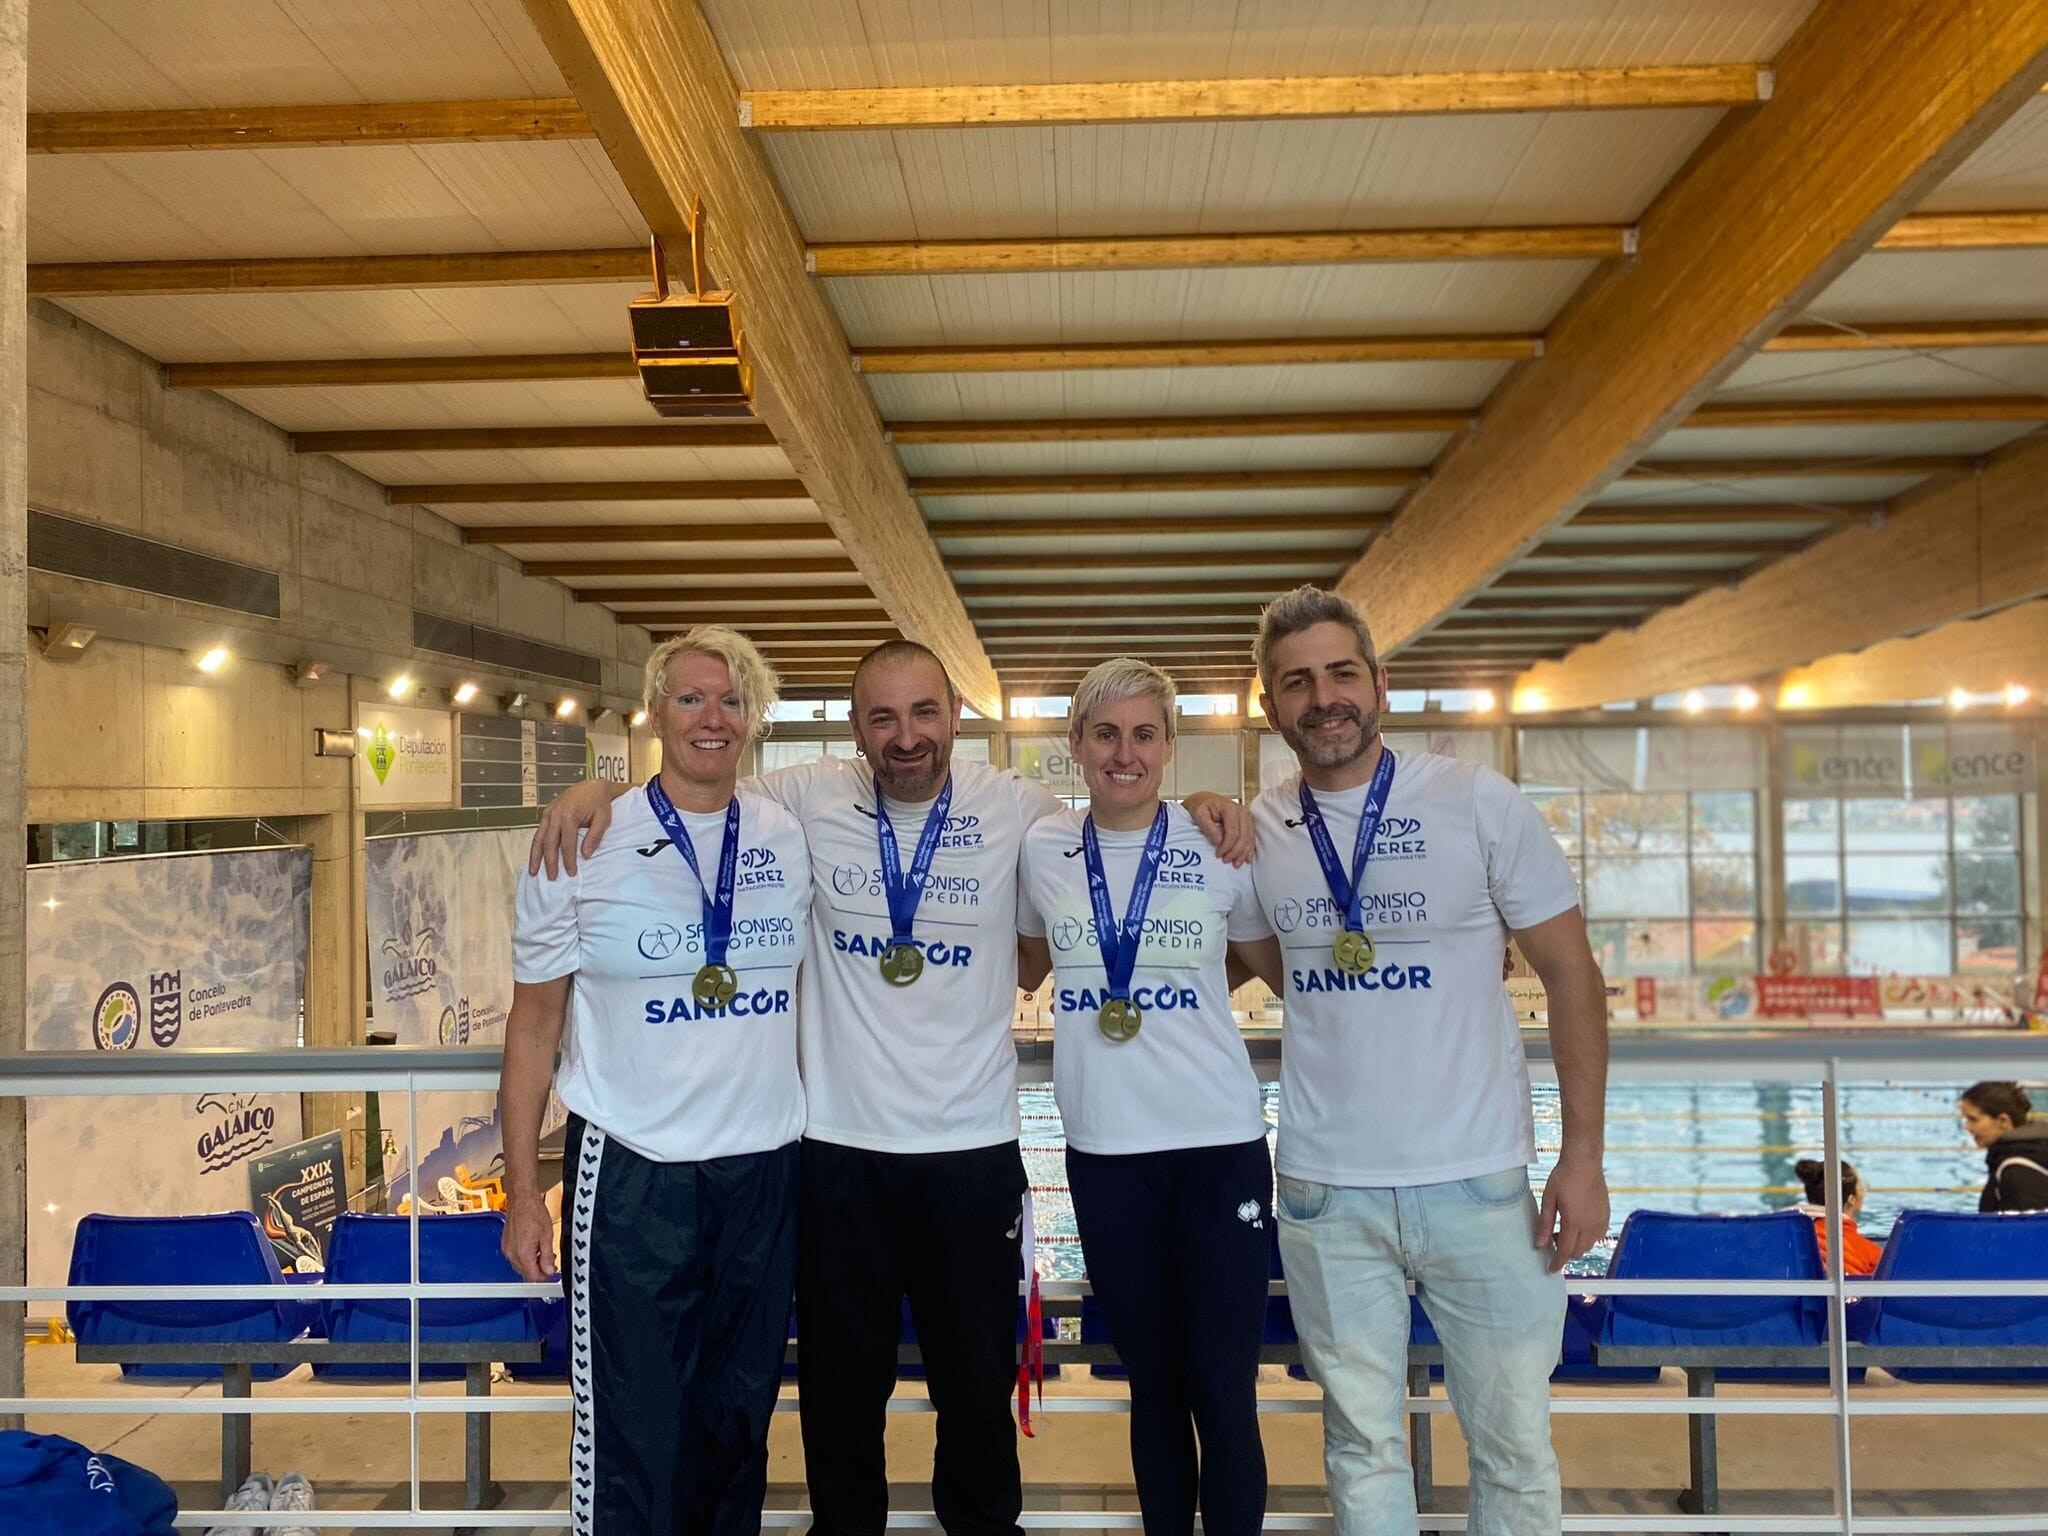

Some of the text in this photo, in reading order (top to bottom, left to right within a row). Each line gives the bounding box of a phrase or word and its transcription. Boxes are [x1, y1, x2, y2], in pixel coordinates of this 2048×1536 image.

[400, 735, 447, 757] Deputación
[598, 754, 625, 782] ence
[1047, 755, 1081, 775] en
[1823, 756, 1895, 779] ence
[1953, 752, 2025, 777] ence
[736, 869, 784, 886] JEREZ
[1159, 870, 1205, 885] EREZ
[868, 885, 979, 906] OPEDIA
[1306, 909, 1428, 928] ORTPEDIA
[686, 934, 795, 954] OOPEDIA
[833, 930, 973, 967] SANOR
[1086, 934, 1203, 950] OPEDIA
[384, 958, 436, 988] GALAICO
[1292, 963, 1432, 993] SANICOR
[188, 984, 226, 1003] Concello
[1060, 984, 1200, 1012] SACOR
[189, 994, 251, 1021] de Pontevedra
[228, 1098, 246, 1114] C.N.
[197, 1106, 275, 1158] GALAICO
[300, 1159, 333, 1183] XXIX
[291, 1177, 334, 1198] CAMPEONATO
[300, 1186, 335, 1206] DE ESPAÑA
